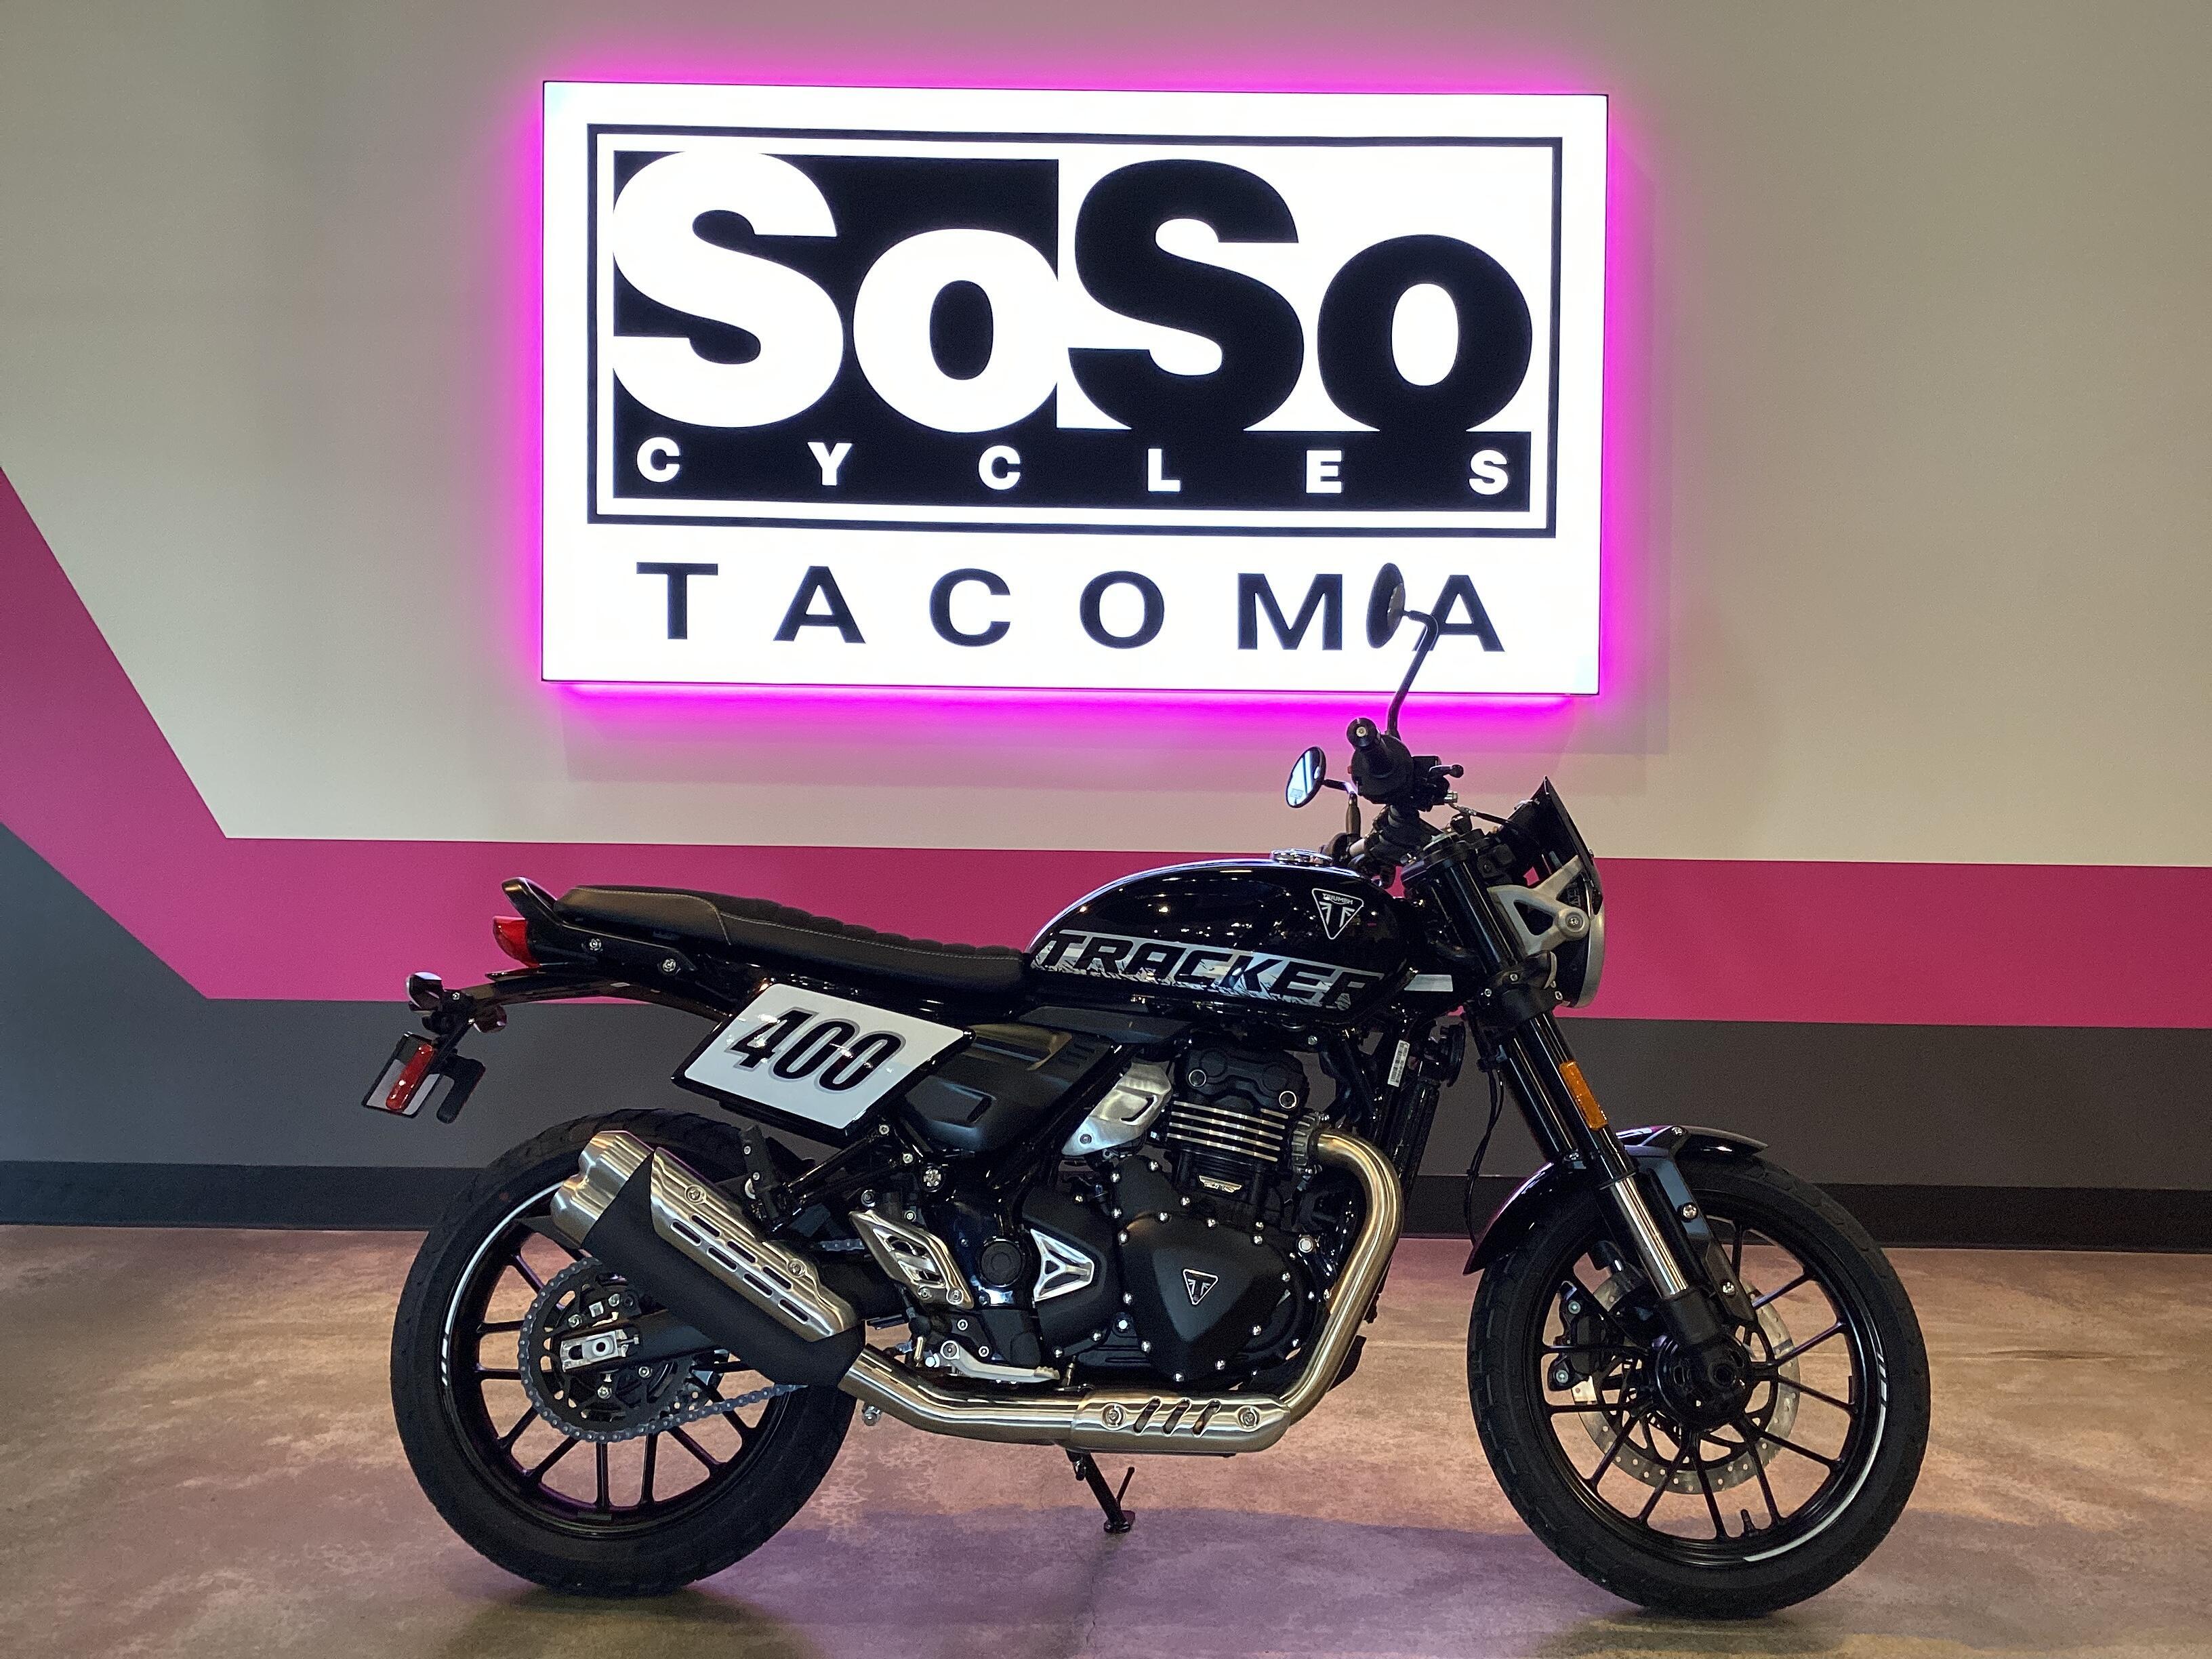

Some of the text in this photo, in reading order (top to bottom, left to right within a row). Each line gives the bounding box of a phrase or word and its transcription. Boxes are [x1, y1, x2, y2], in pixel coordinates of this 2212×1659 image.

[613, 150, 1533, 434] SoSo
[636, 436, 1509, 495] CYCLES
[636, 562, 1505, 652] TACOMA
[1040, 933, 1382, 1010] TRACKER
[724, 1006, 907, 1095] 400
